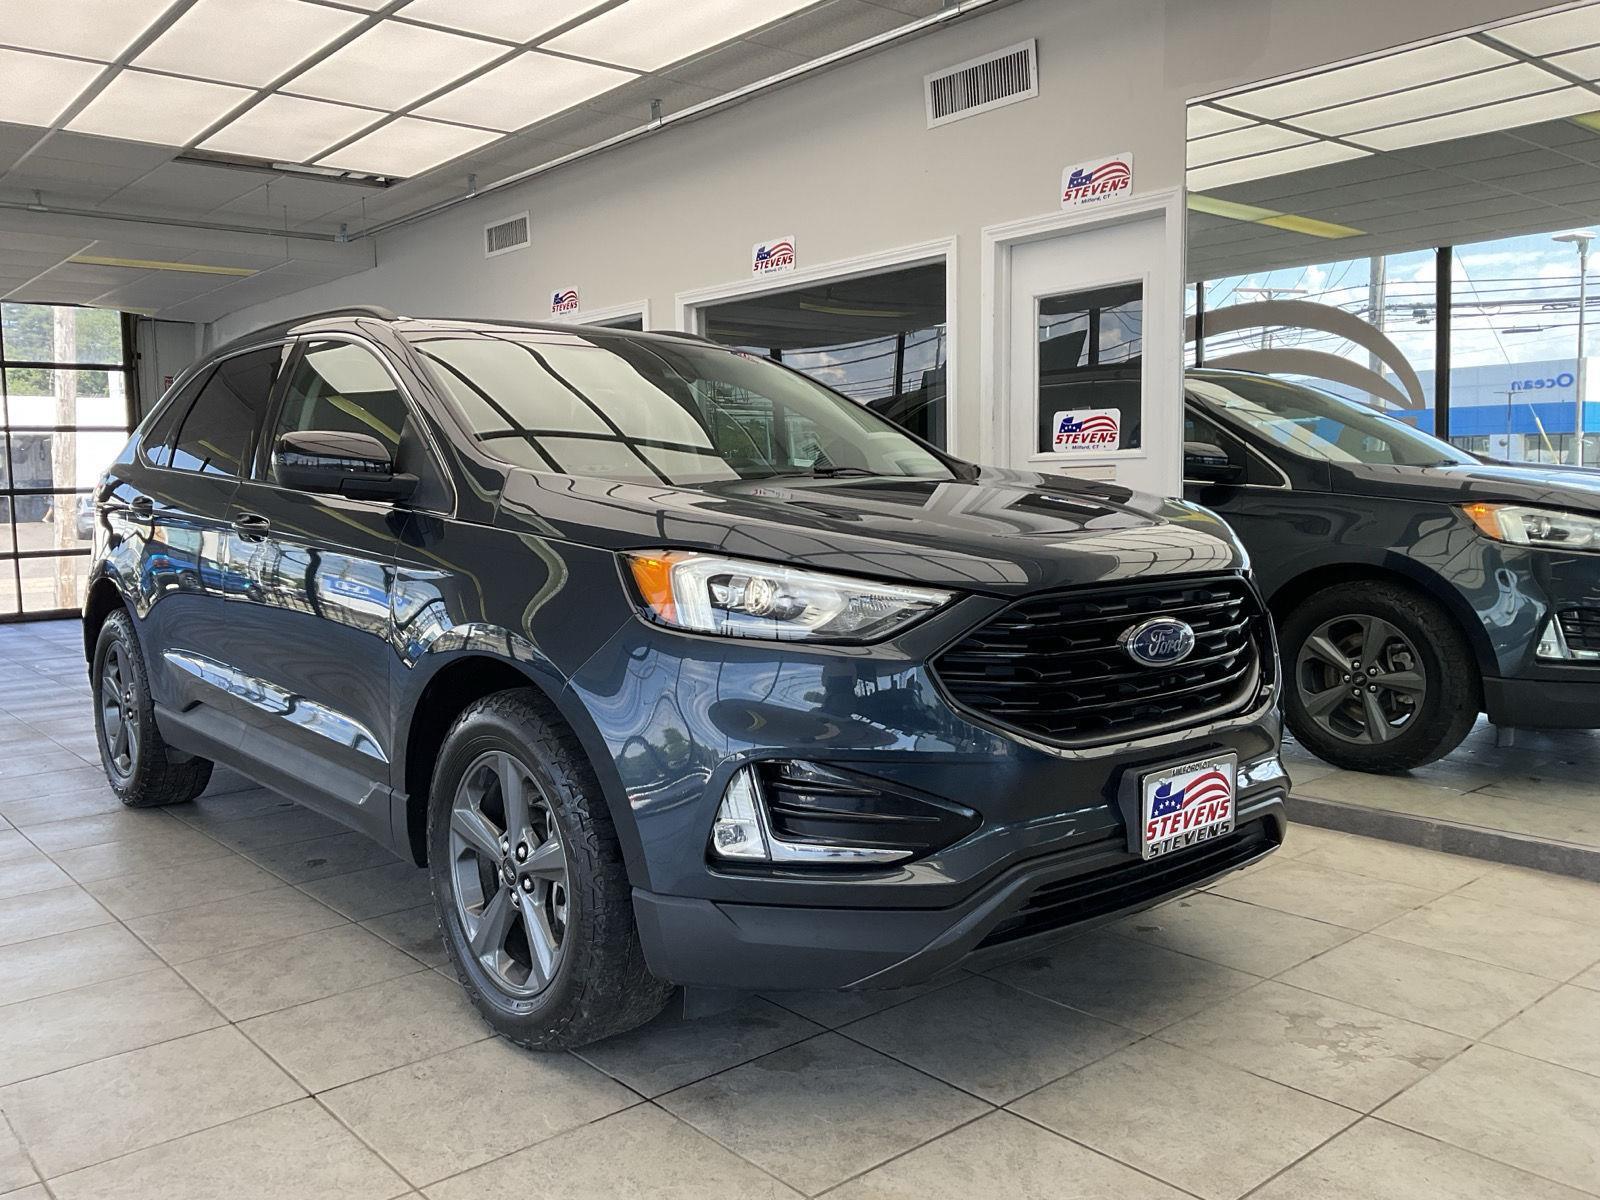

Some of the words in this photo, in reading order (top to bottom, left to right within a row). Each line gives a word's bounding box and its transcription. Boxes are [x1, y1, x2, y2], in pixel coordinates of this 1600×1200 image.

[1063, 177, 1130, 202] STEVENS
[753, 255, 794, 272] STEVENS
[552, 301, 578, 313] STEVENS
[1055, 432, 1117, 445] STEVENS
[1149, 628, 1184, 656] Ford
[1146, 798, 1230, 841] STEVENS
[1148, 820, 1230, 858] STEVENS
